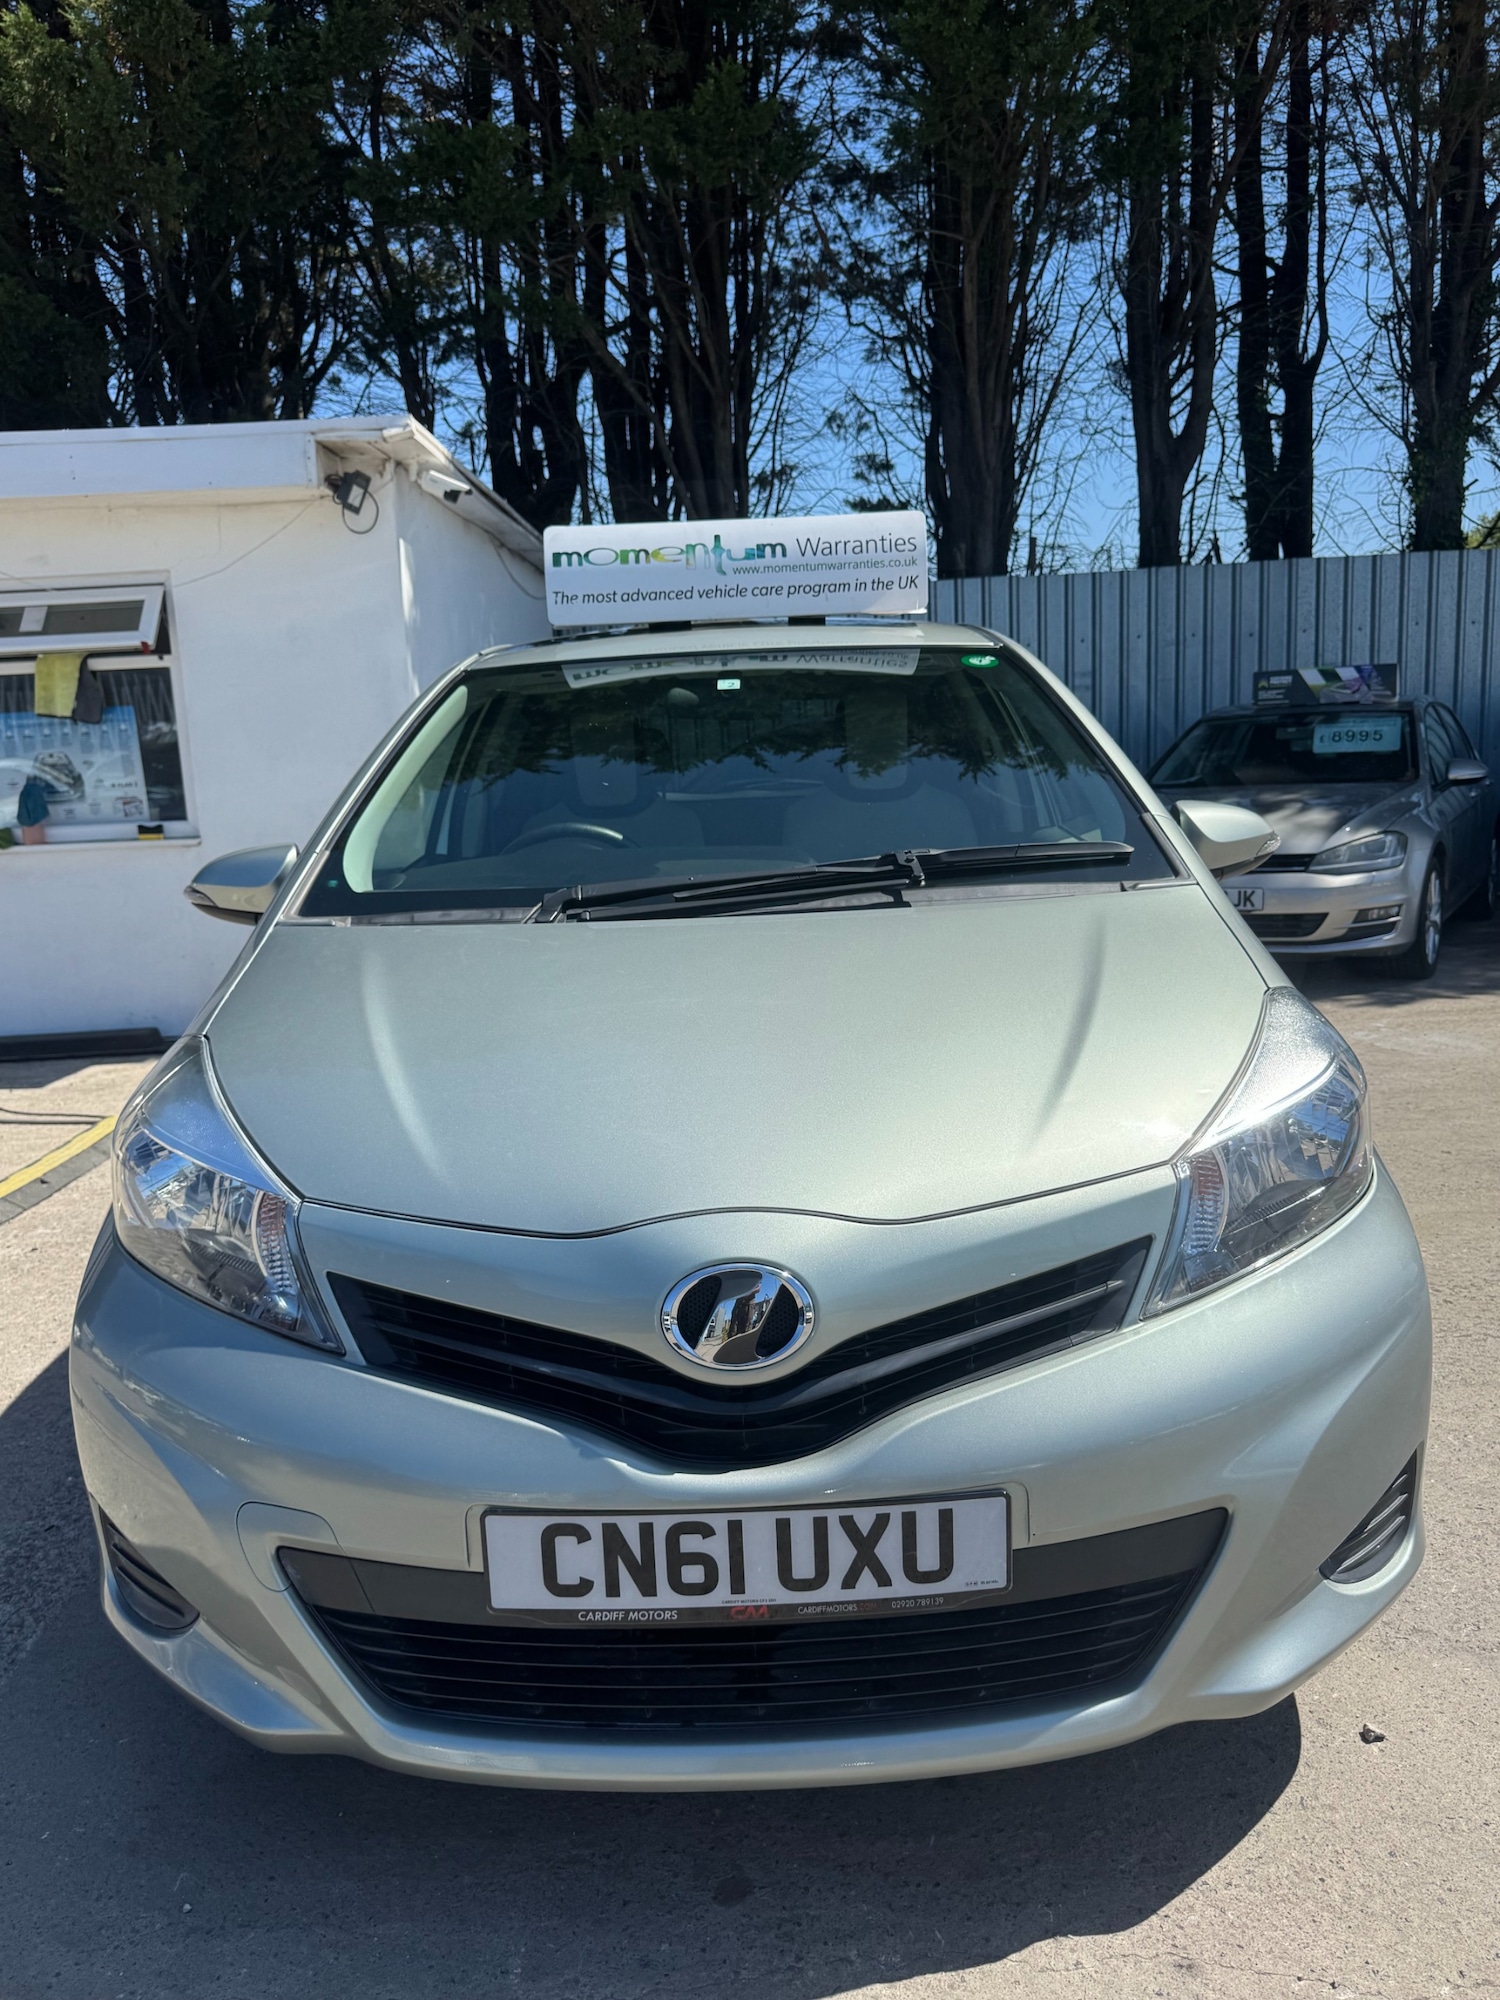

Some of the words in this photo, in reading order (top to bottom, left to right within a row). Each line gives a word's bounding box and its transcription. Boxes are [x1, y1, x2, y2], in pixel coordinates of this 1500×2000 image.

[552, 534, 787, 576] momentum
[796, 533, 918, 557] Warranties
[732, 556, 918, 575] www.momentumwarranties.co.uk
[552, 590, 579, 605] The
[582, 589, 618, 604] most
[621, 586, 694, 603] advanced
[697, 584, 748, 599] vehicle
[751, 584, 784, 597] care
[787, 580, 851, 598] program
[854, 577, 868, 592] in
[871, 576, 894, 591] the
[897, 574, 920, 590] UK
[1331, 729, 1384, 744] 8995
[1224, 890, 1256, 908] JK
[540, 1519, 746, 1598] CN61
[775, 1507, 955, 1592] UXU
[891, 1599, 915, 1609] 02920
[916, 1596, 944, 1607] 789139
[577, 1610, 625, 1622] CARDIFF
[627, 1609, 678, 1621] MOTORS
